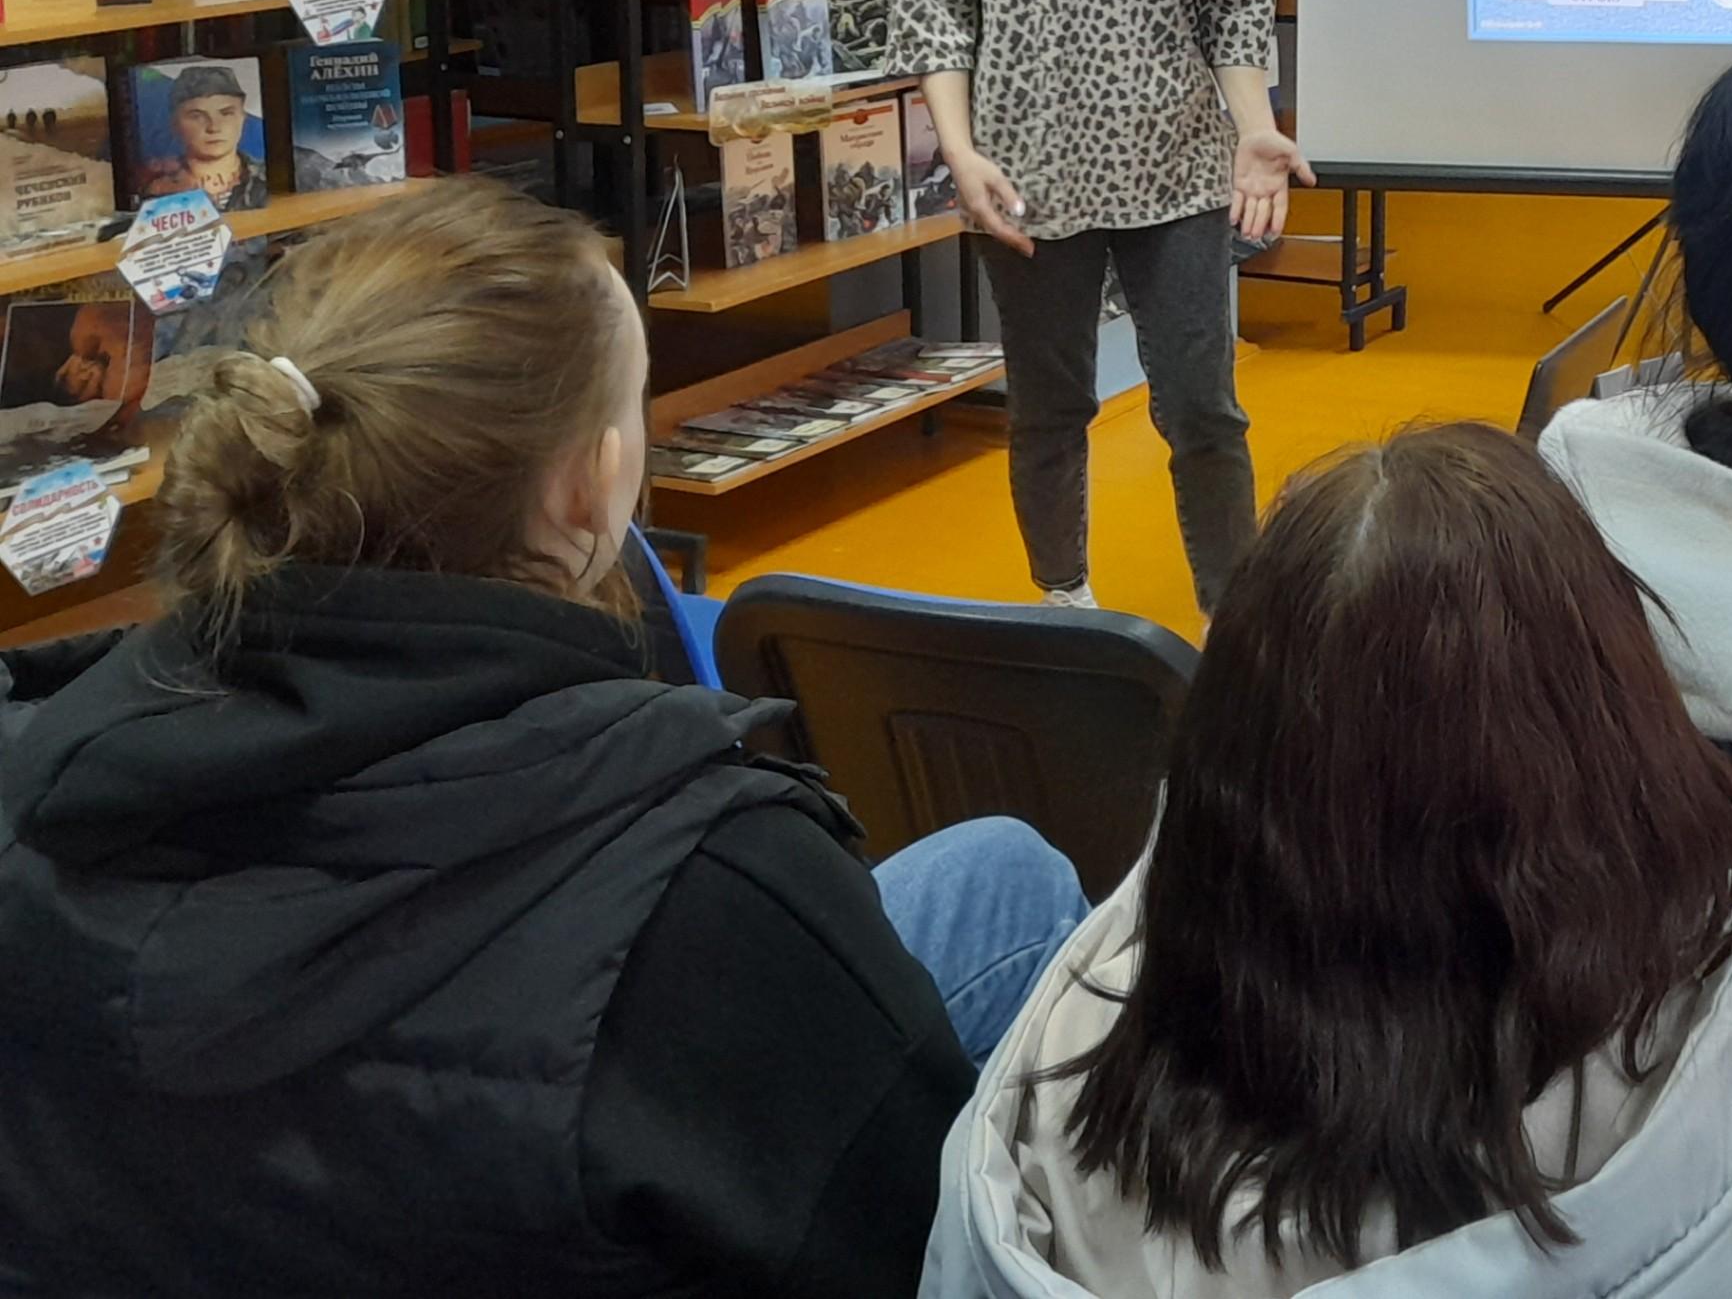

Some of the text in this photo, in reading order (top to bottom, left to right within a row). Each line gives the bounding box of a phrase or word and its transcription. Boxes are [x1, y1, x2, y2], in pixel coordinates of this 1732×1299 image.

[310, 52, 378, 67] Геннадий
[152, 210, 195, 232] ЧЕСТЬ
[12, 480, 99, 516] СОЛИДАРНОСТЬ
